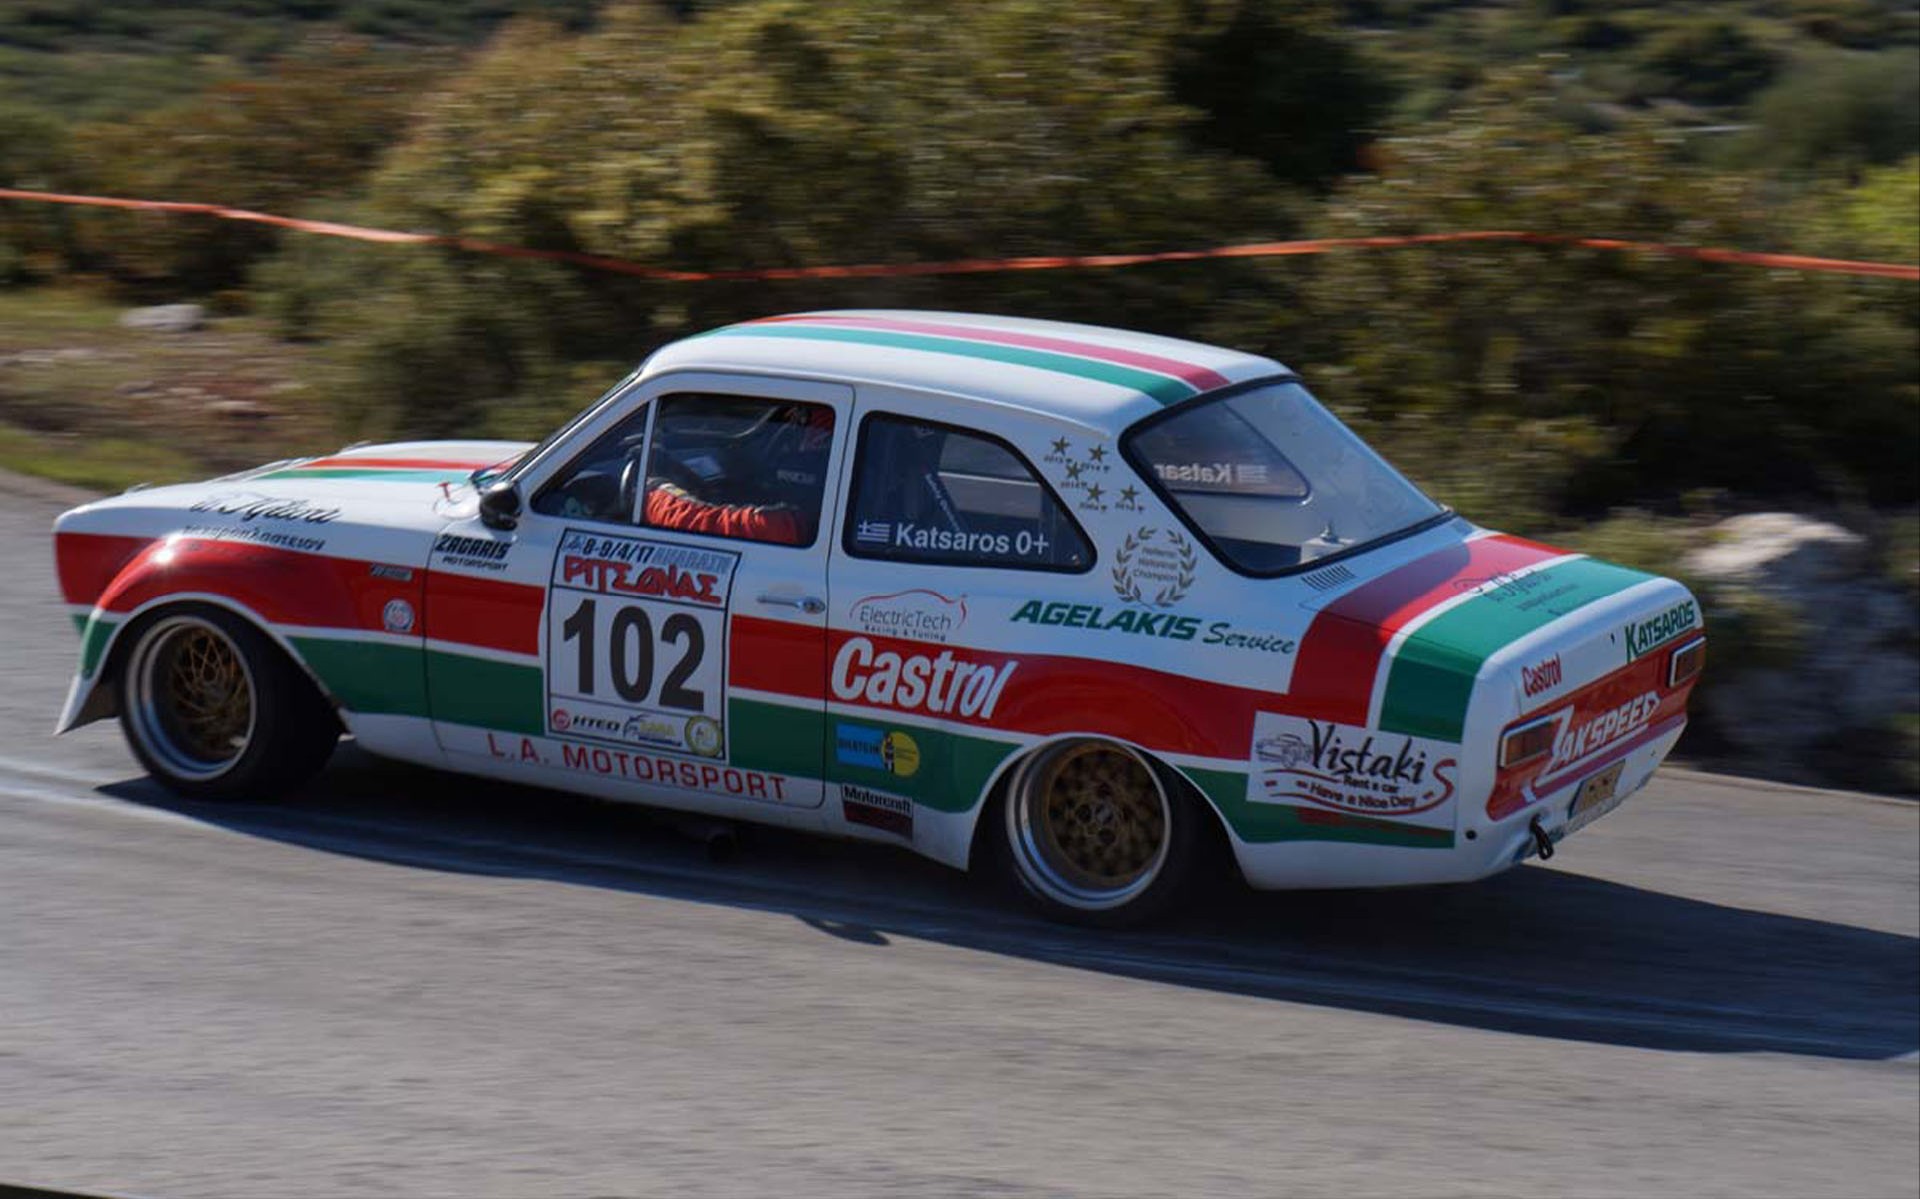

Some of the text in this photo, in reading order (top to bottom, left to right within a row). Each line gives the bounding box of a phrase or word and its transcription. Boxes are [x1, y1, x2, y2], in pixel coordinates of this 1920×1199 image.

[582, 538, 655, 564] 8-9/4/17
[895, 522, 1010, 554] Katsaros
[859, 604, 952, 630] ElectricTech
[1011, 600, 1296, 655] AGELAKIS Service
[1624, 600, 1696, 664] KATSAROS
[563, 599, 705, 712] 102
[831, 636, 1019, 720] Castrol
[1521, 653, 1562, 697] Castrol
[487, 732, 787, 800] L.A. MOTORSPORT
[1535, 691, 1661, 787] ZAKSPEED
